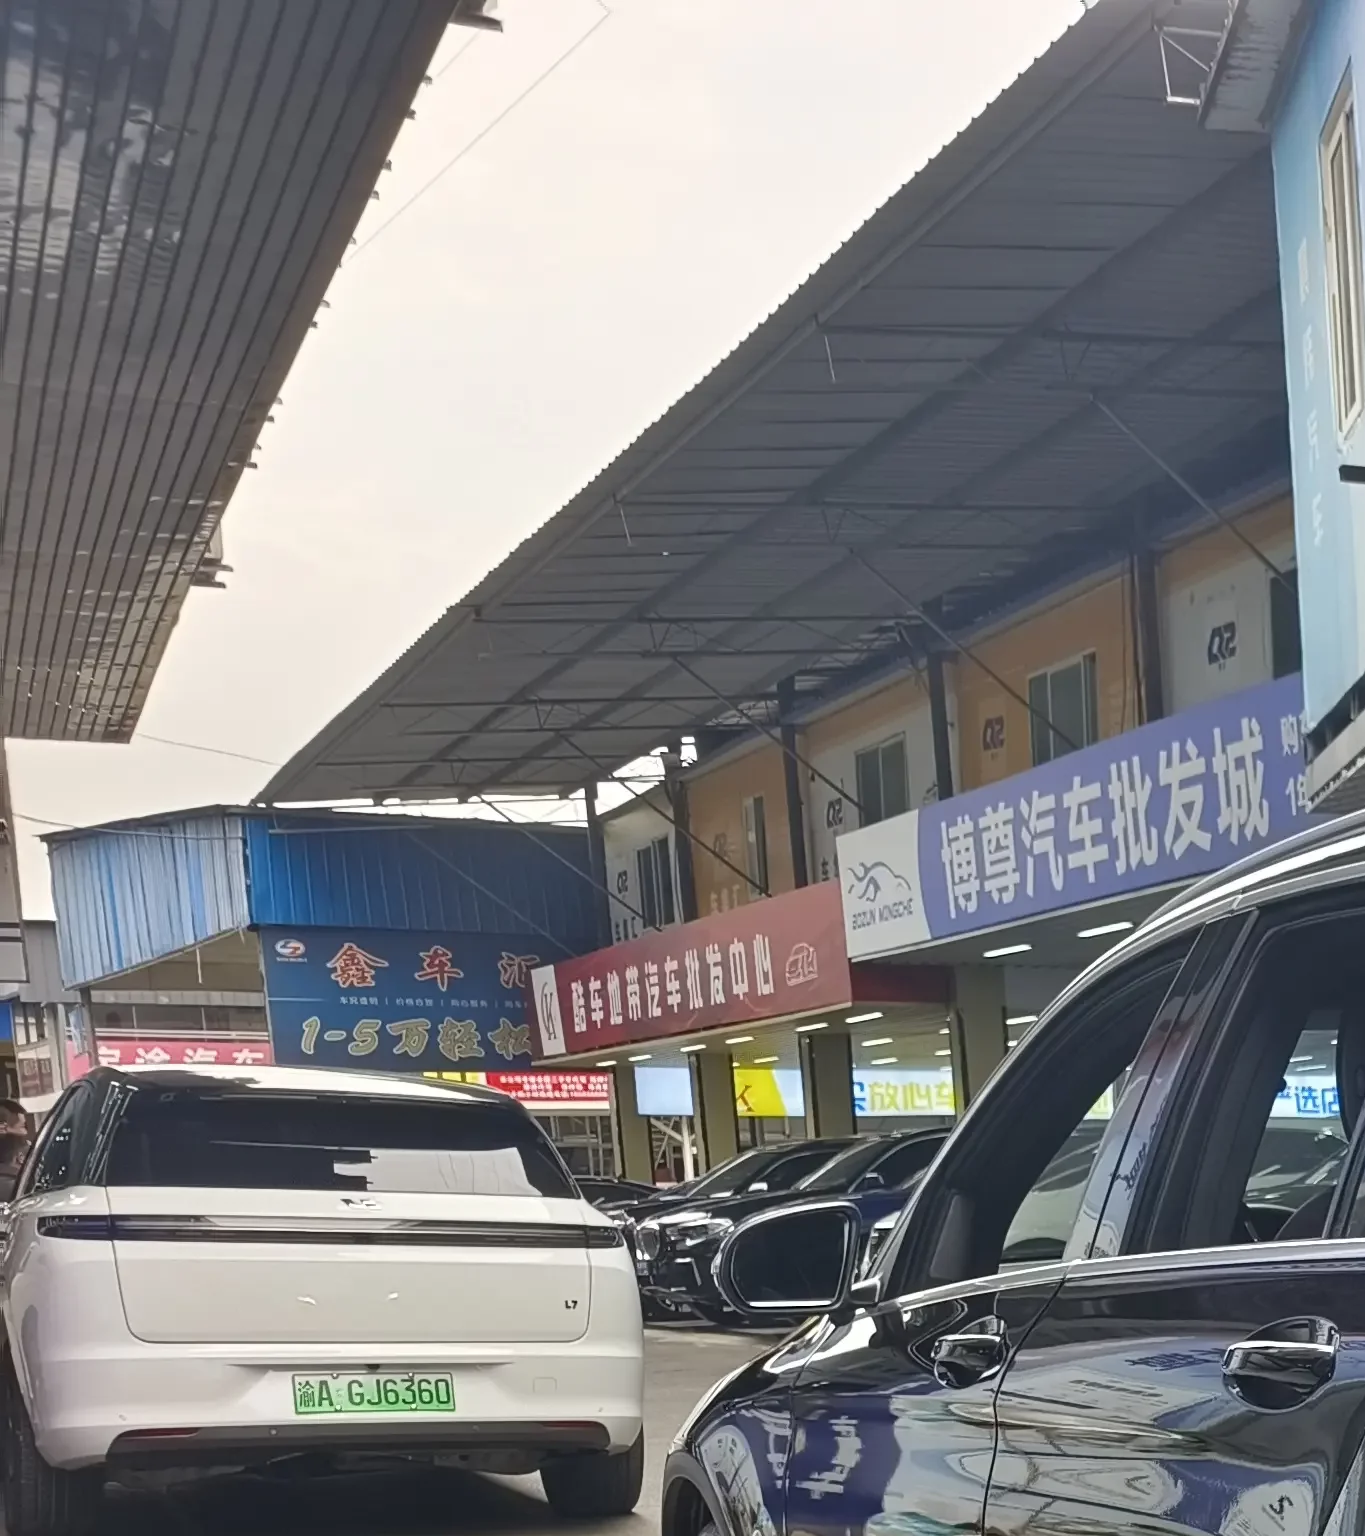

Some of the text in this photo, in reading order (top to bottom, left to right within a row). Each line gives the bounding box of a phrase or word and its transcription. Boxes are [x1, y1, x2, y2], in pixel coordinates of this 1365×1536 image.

[940, 716, 1269, 920] 博尊汽车批发城
[571, 933, 774, 1033] 酷车地带汽车批发中心
